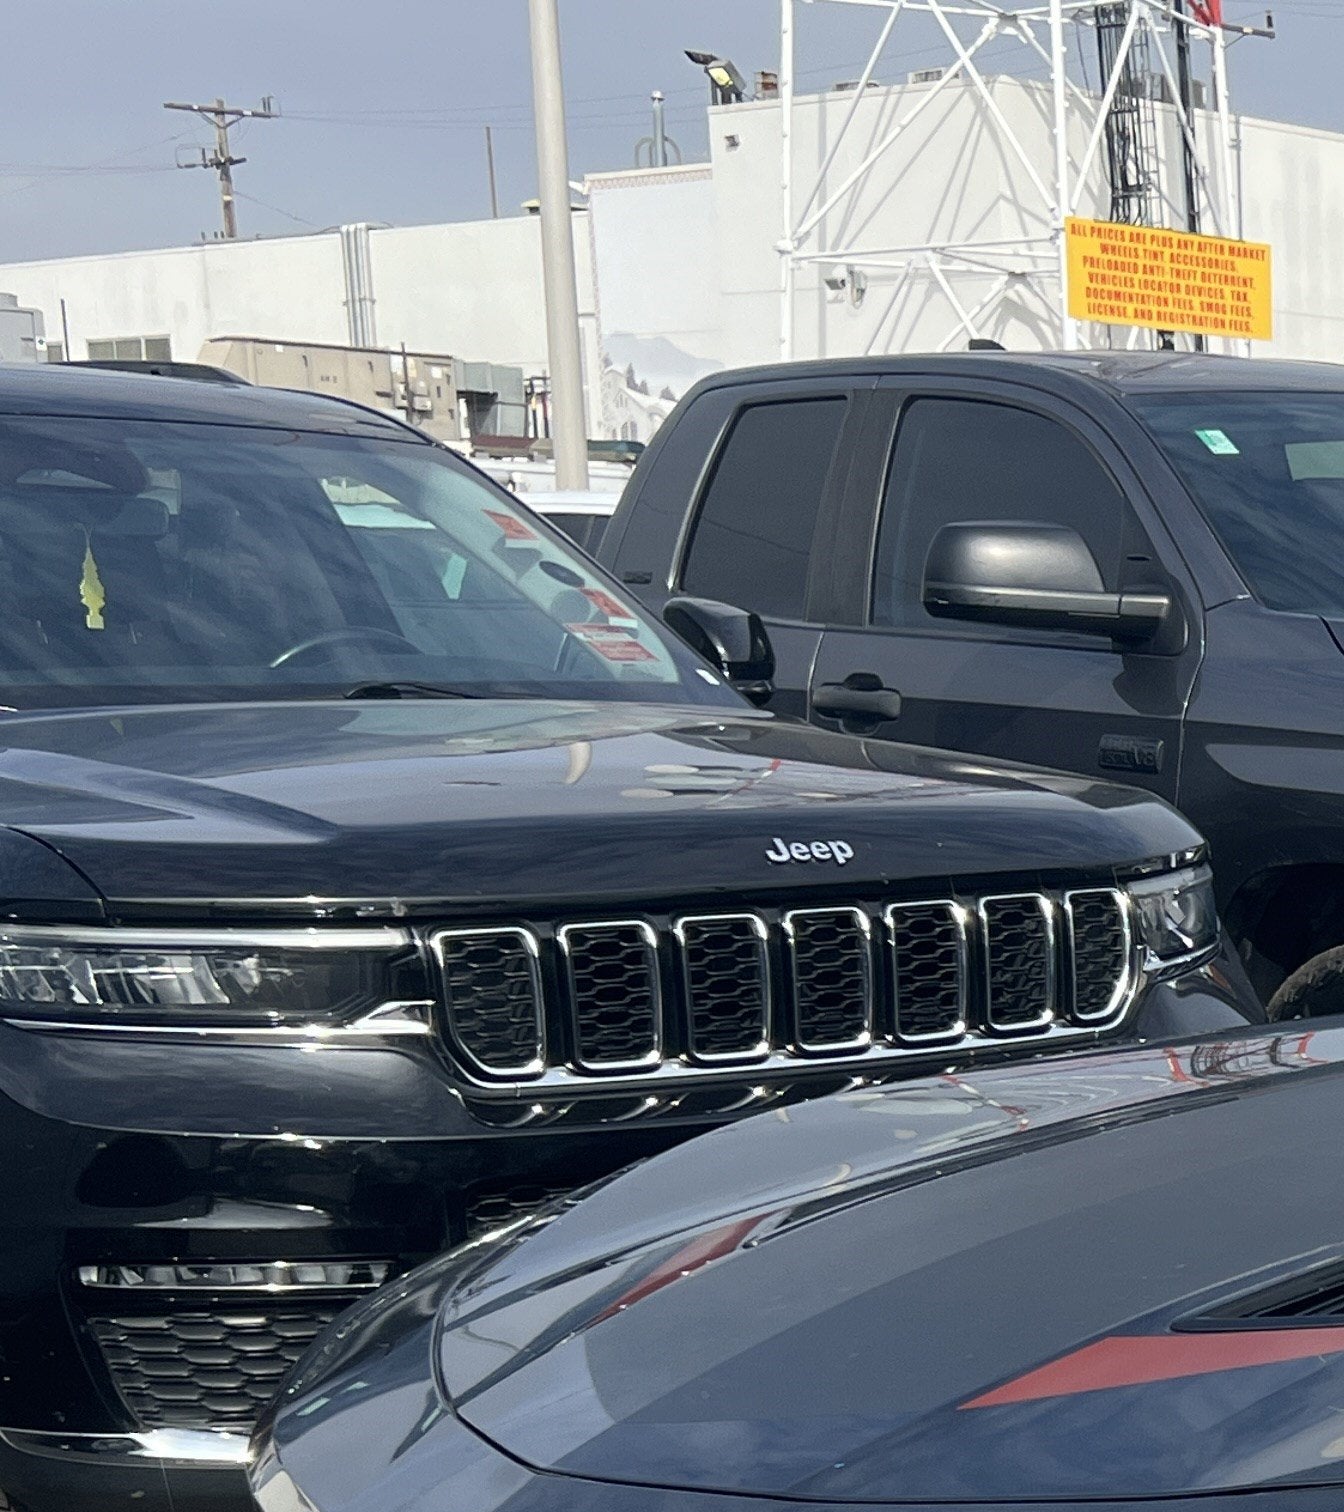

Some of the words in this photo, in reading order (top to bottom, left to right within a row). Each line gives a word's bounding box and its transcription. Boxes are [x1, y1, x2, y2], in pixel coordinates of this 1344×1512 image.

[1071, 223, 1087, 237] ALL
[1090, 226, 1126, 242] PRICES
[1129, 231, 1147, 245] ARE
[1150, 234, 1174, 249] PLUS
[1177, 238, 1195, 251] ANY
[1197, 241, 1225, 256] AFTER
[1228, 245, 1266, 261] MARKET
[1082, 255, 1139, 274] PRELOADED
[1087, 271, 1136, 288] VEHICLES
[1138, 278, 1181, 294] LOCATOR
[1085, 286, 1169, 308] DOCUMENTATION
[1200, 301, 1227, 315] SMOG
[1133, 307, 1153, 321] AND
[1156, 311, 1226, 329] REGISTRATION
[765, 837, 854, 864] Jeep
